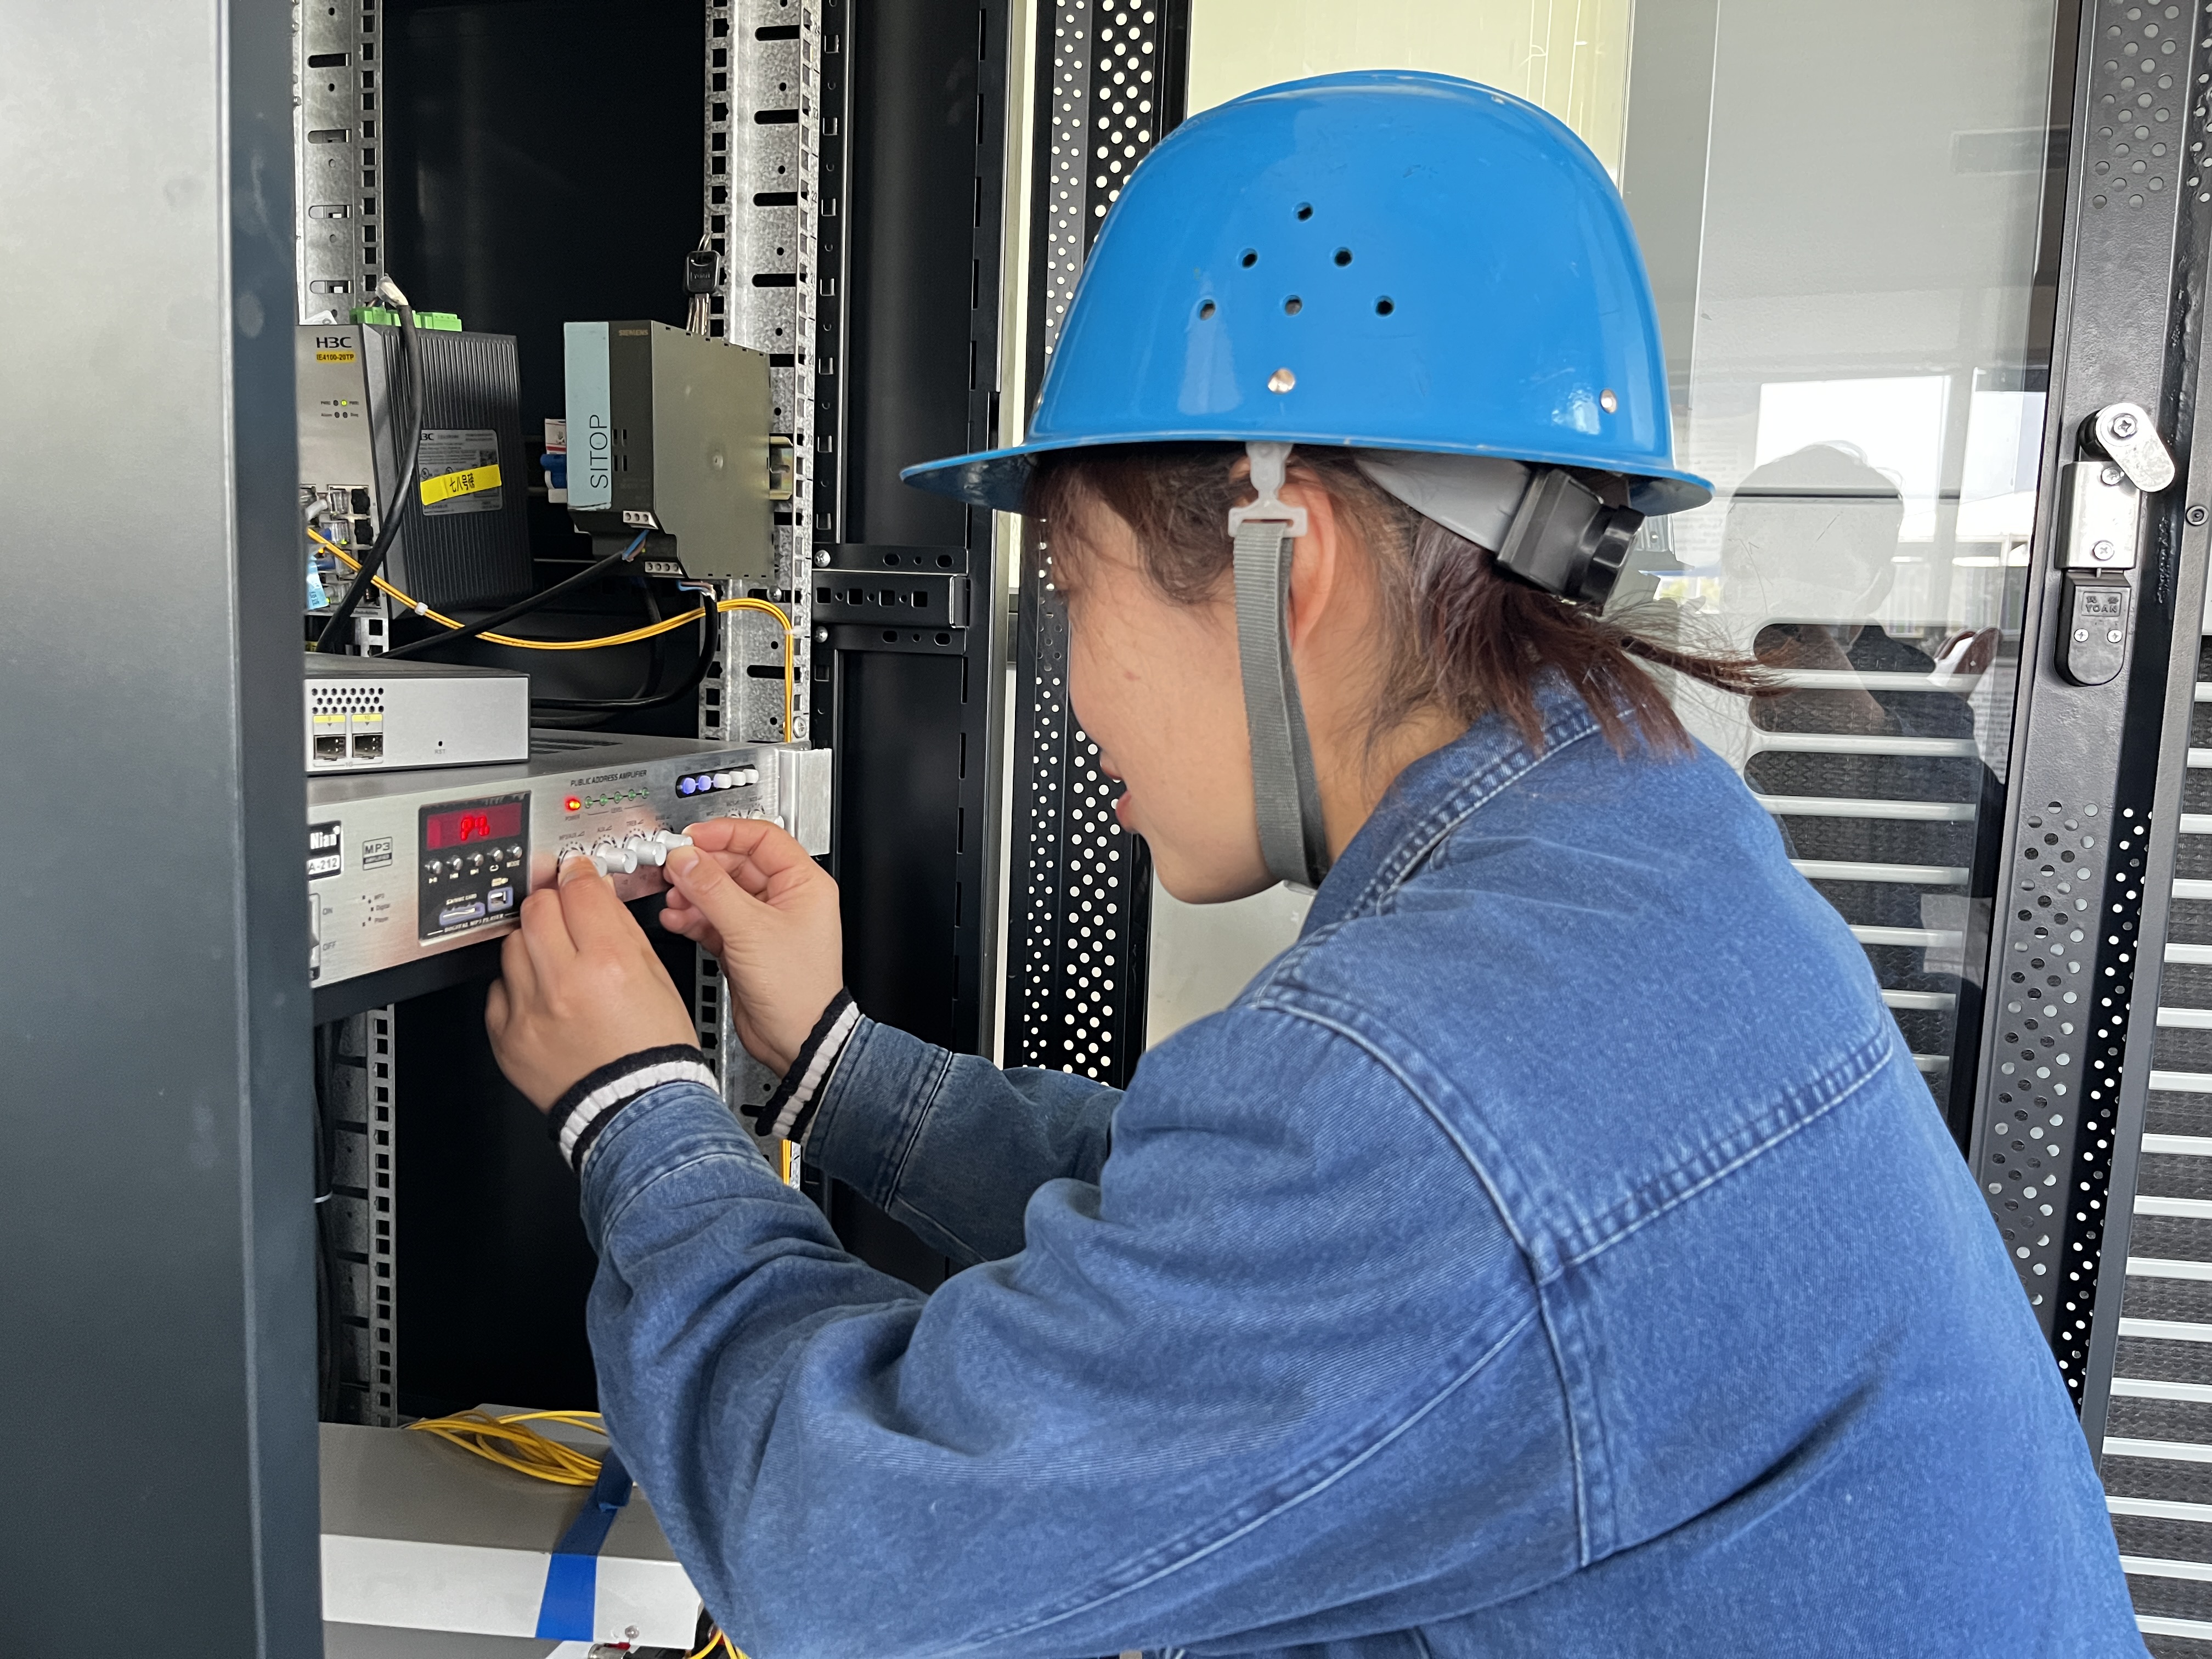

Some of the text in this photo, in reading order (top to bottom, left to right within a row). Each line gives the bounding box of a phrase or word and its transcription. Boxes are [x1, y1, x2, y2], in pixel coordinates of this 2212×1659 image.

[316, 337, 352, 348] H3C
[589, 414, 608, 488] SITOP
[571, 770, 647, 787] PUBLIC ADDRESS AMPLIFIER
[365, 842, 390, 854] MP3
[323, 941, 336, 951] OFF
